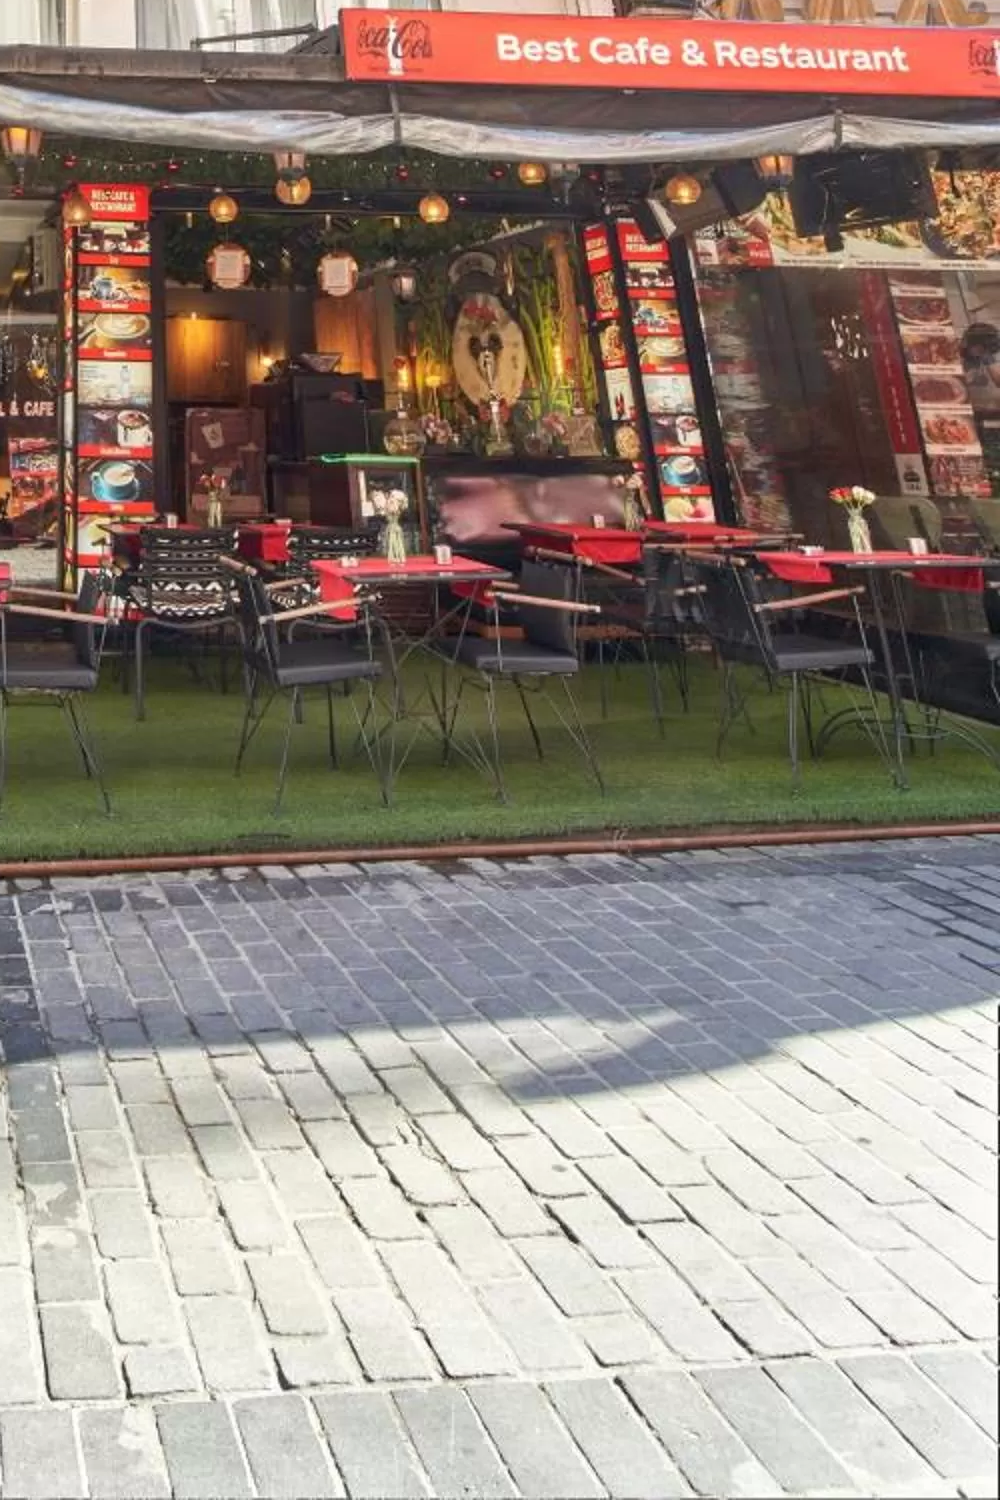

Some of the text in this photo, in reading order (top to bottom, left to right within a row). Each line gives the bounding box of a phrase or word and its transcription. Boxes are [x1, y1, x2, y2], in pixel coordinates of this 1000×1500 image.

[496, 33, 911, 73] Best Cafe & Restaurant
[9, 401, 18, 417] &
[26, 401, 55, 417] CAFE
